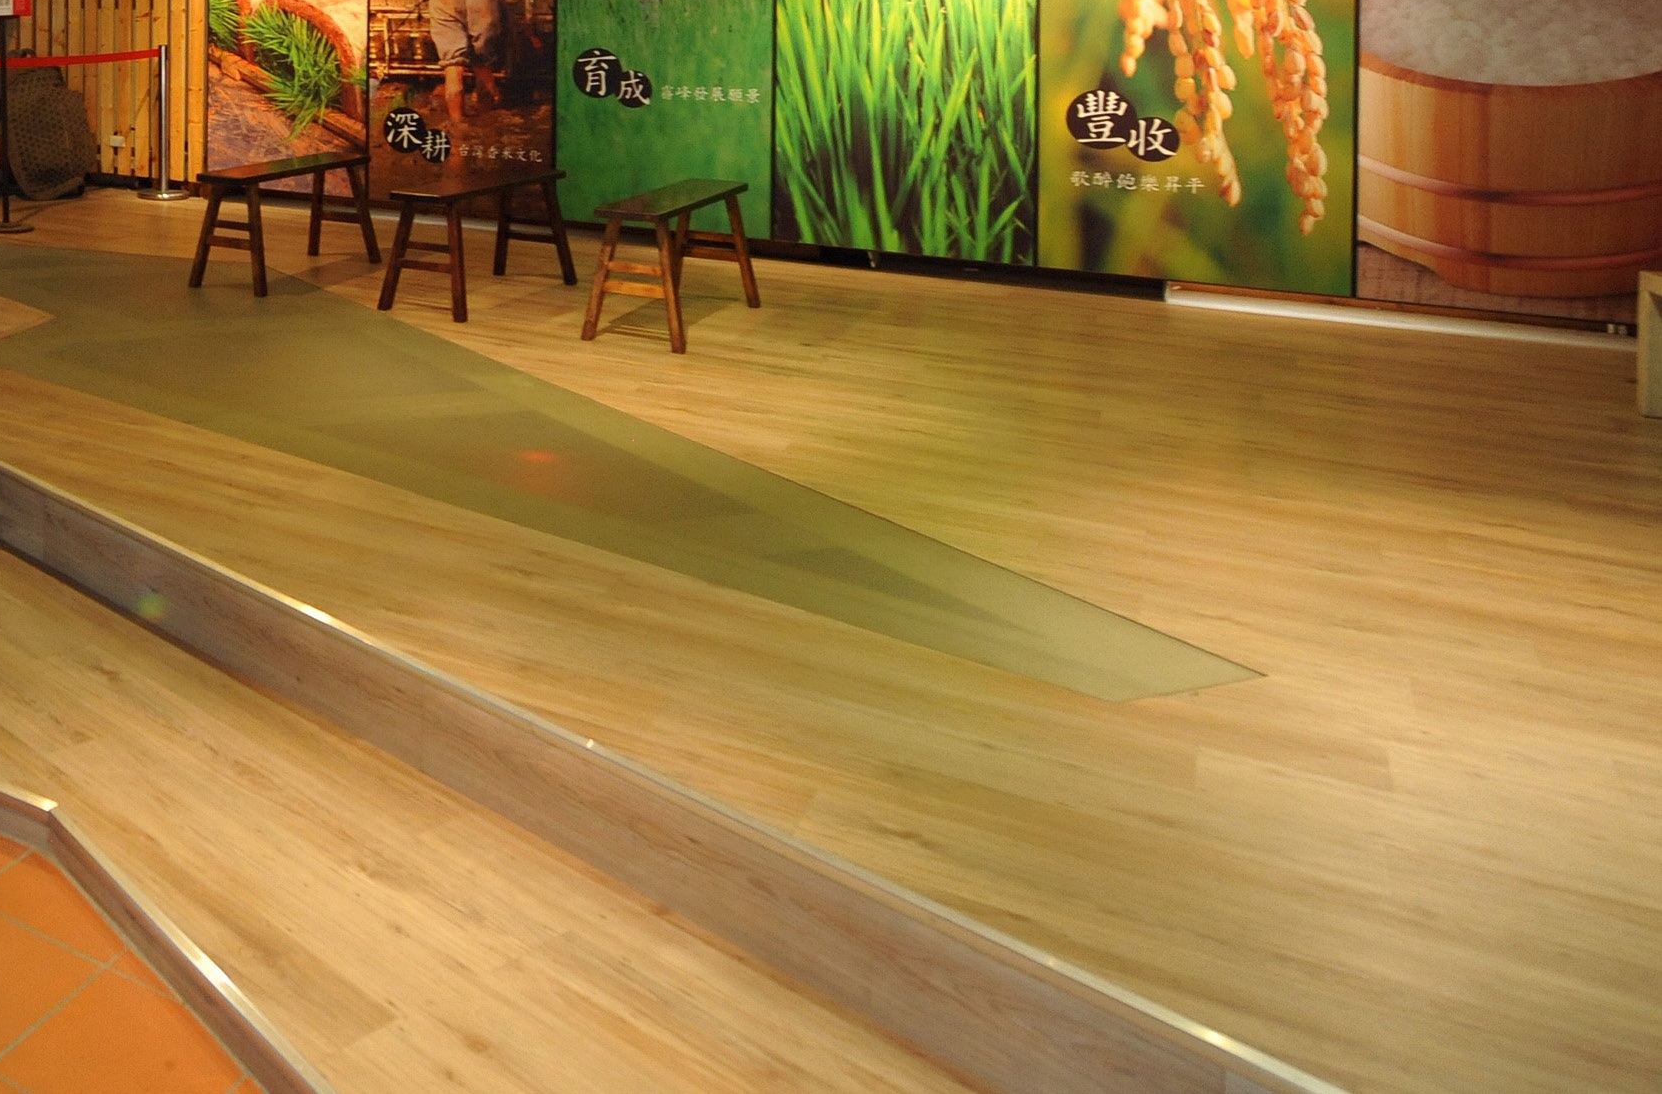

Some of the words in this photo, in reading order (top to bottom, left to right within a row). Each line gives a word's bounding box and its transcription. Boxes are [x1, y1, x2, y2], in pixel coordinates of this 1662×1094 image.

[577, 50, 650, 105] 育成
[387, 113, 451, 162] 深耕
[1076, 90, 1178, 156] 豐收
